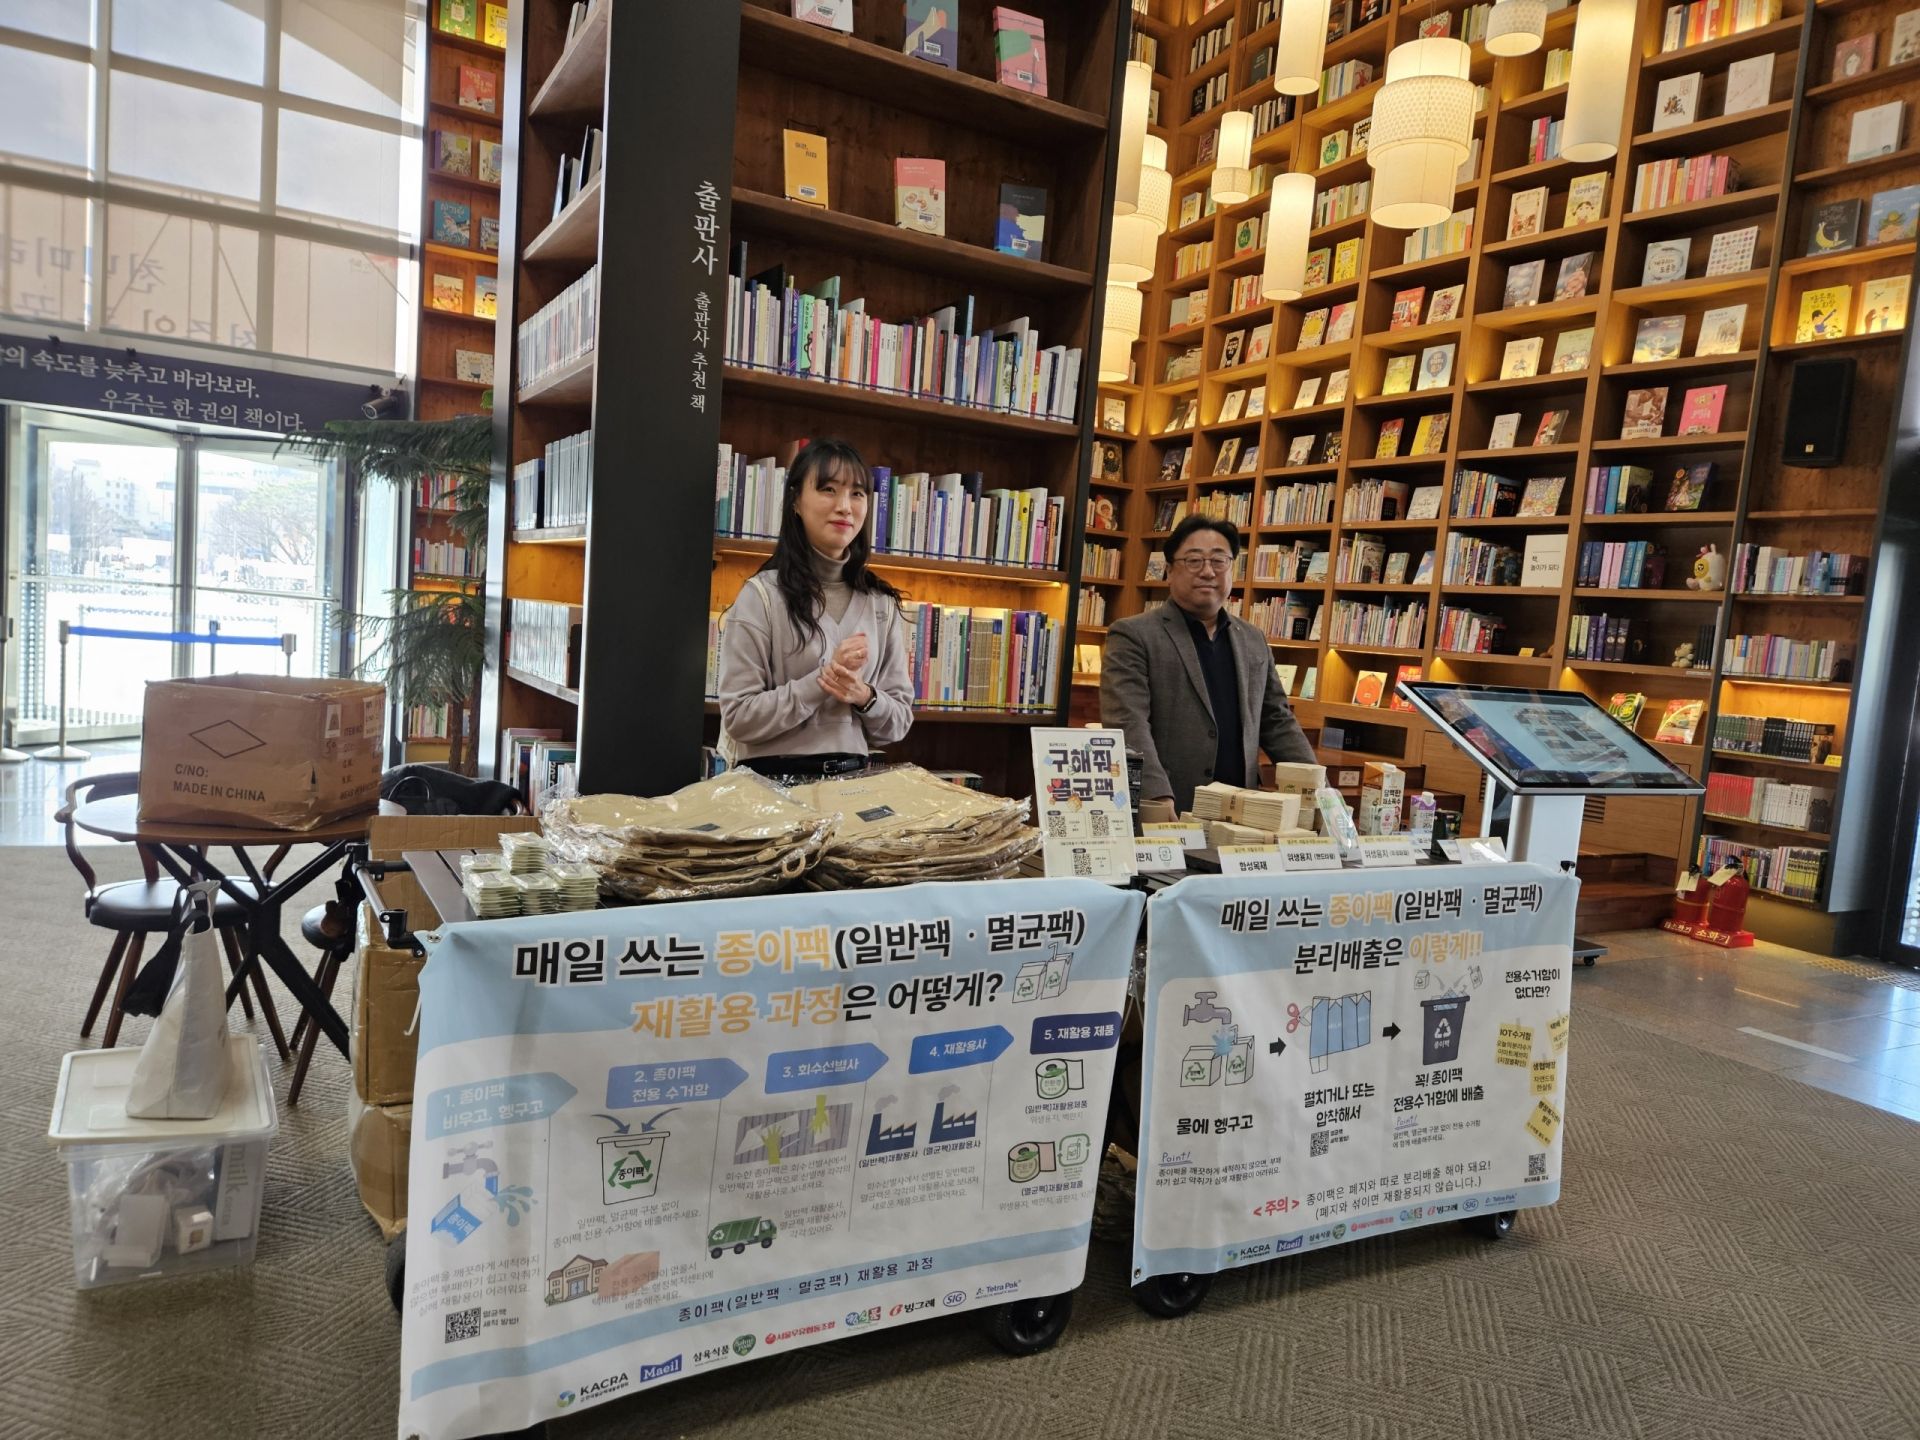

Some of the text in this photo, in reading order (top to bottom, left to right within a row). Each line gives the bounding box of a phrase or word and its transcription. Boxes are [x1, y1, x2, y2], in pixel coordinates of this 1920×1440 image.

[691, 180, 721, 276] 출판사
[690, 292, 711, 413] 출판사 추천 책
[0, 344, 260, 399] 의 속도를 늦추고 바라보라.
[100, 389, 307, 432] 우주는 한 권의 책이다.
[175, 763, 209, 778] C/NO:
[1049, 749, 1112, 773] 구해줘
[173, 780, 266, 802] MADE IN CHINA
[1051, 778, 1114, 801] 멸균팩
[1239, 861, 1268, 871] 합성목재
[1221, 898, 1271, 932] 매일
[1276, 898, 1323, 928] 쓰는
[1483, 885, 1544, 915] 멸균팩)
[516, 938, 605, 985] 매일
[619, 937, 704, 977] 쓰는
[988, 910, 1085, 953] 멸균팩)
[1294, 932, 1483, 973] 분리배출은 이렇게!!
[1505, 969, 1560, 983] 전용수거함이
[1515, 986, 1550, 999] 없다면?
[633, 973, 1003, 1039] 재활용 과정은 어떻게?
[1058, 1026, 1091, 1040] 재활용
[1093, 1024, 1114, 1037] 제품
[943, 1038, 987, 1055] 재활용사
[653, 1065, 696, 1081] 종이팩
[798, 1059, 860, 1077] 회수선별사
[1415, 1068, 1463, 1087] 꼭! 종이팩
[460, 1083, 505, 1104] 종이팩
[632, 1084, 709, 1103] 전용 수거함
[1304, 1082, 1375, 1108] 펼치거나 또는
[1393, 1085, 1485, 1113] 전용수거함에 배출
[443, 1108, 492, 1130] 비우고,
[1177, 1114, 1253, 1135] 물에 헹구고
[1316, 1105, 1361, 1127] 압착해서
[618, 1167, 645, 1179] 종이팩
[1306, 1187, 1344, 1206] 종이팩은
[1349, 1180, 1376, 1196] 폐지와
[1380, 1175, 1400, 1187] 따로
[1403, 1166, 1441, 1184] 분리배출
[1445, 1163, 1464, 1176] 해야
[1468, 1160, 1491, 1173] 돼요!
[1315, 1201, 1347, 1220] (폐지와
[1352, 1195, 1379, 1211] 섞이면
[1384, 1184, 1431, 1202] 재활용되지
[1240, 1243, 1271, 1255] KACRA
[1279, 1239, 1303, 1251] Maeil
[857, 1263, 899, 1282] 재활용
[906, 1257, 934, 1273] 과정
[903, 1298, 936, 1314] 빙그레
[643, 1359, 680, 1381] Maeil
[580, 1372, 629, 1396] KACRA
